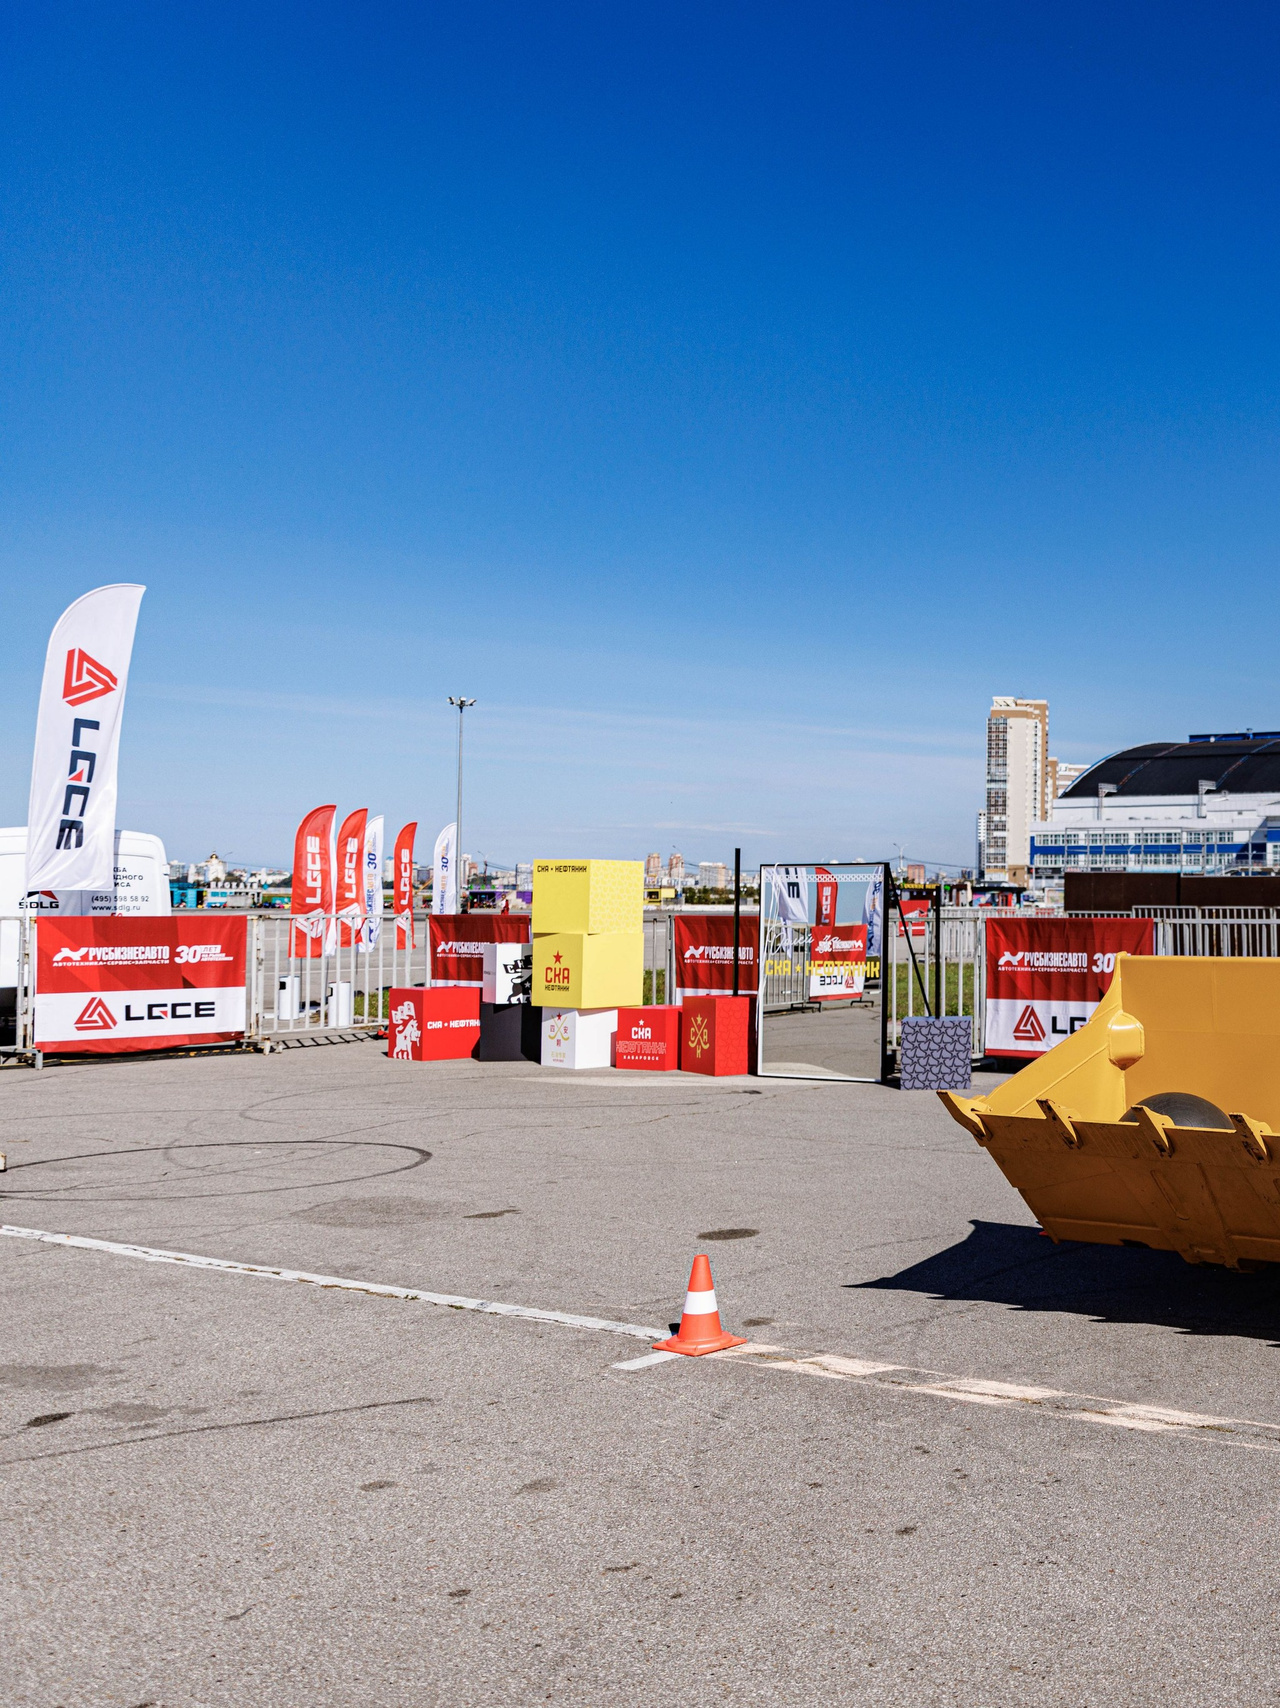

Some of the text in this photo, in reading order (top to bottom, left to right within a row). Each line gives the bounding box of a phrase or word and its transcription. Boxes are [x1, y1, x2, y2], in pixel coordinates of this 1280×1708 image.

[56, 718, 100, 850] LGCE
[306, 836, 322, 904] LGCE
[344, 837, 358, 898] LGCE
[368, 852, 377, 870] 30
[441, 857, 449, 872] 30
[400, 849, 410, 905] LGCE
[88, 945, 201, 964] РУСБИЗНЕСАВТО 30
[704, 946, 753, 960] РУСБИЗНЕАВТО
[765, 960, 880, 978] СКА НЕФТЯНИК
[1024, 952, 1115, 973] РУСБИЗНЕСАВТО 30
[545, 967, 570, 984] СКА
[125, 1002, 215, 1021] LGCE
[427, 1020, 442, 1029] СКА
[631, 1027, 652, 1039] СКА
[616, 1041, 666, 1054] НЕФТЯНИК
